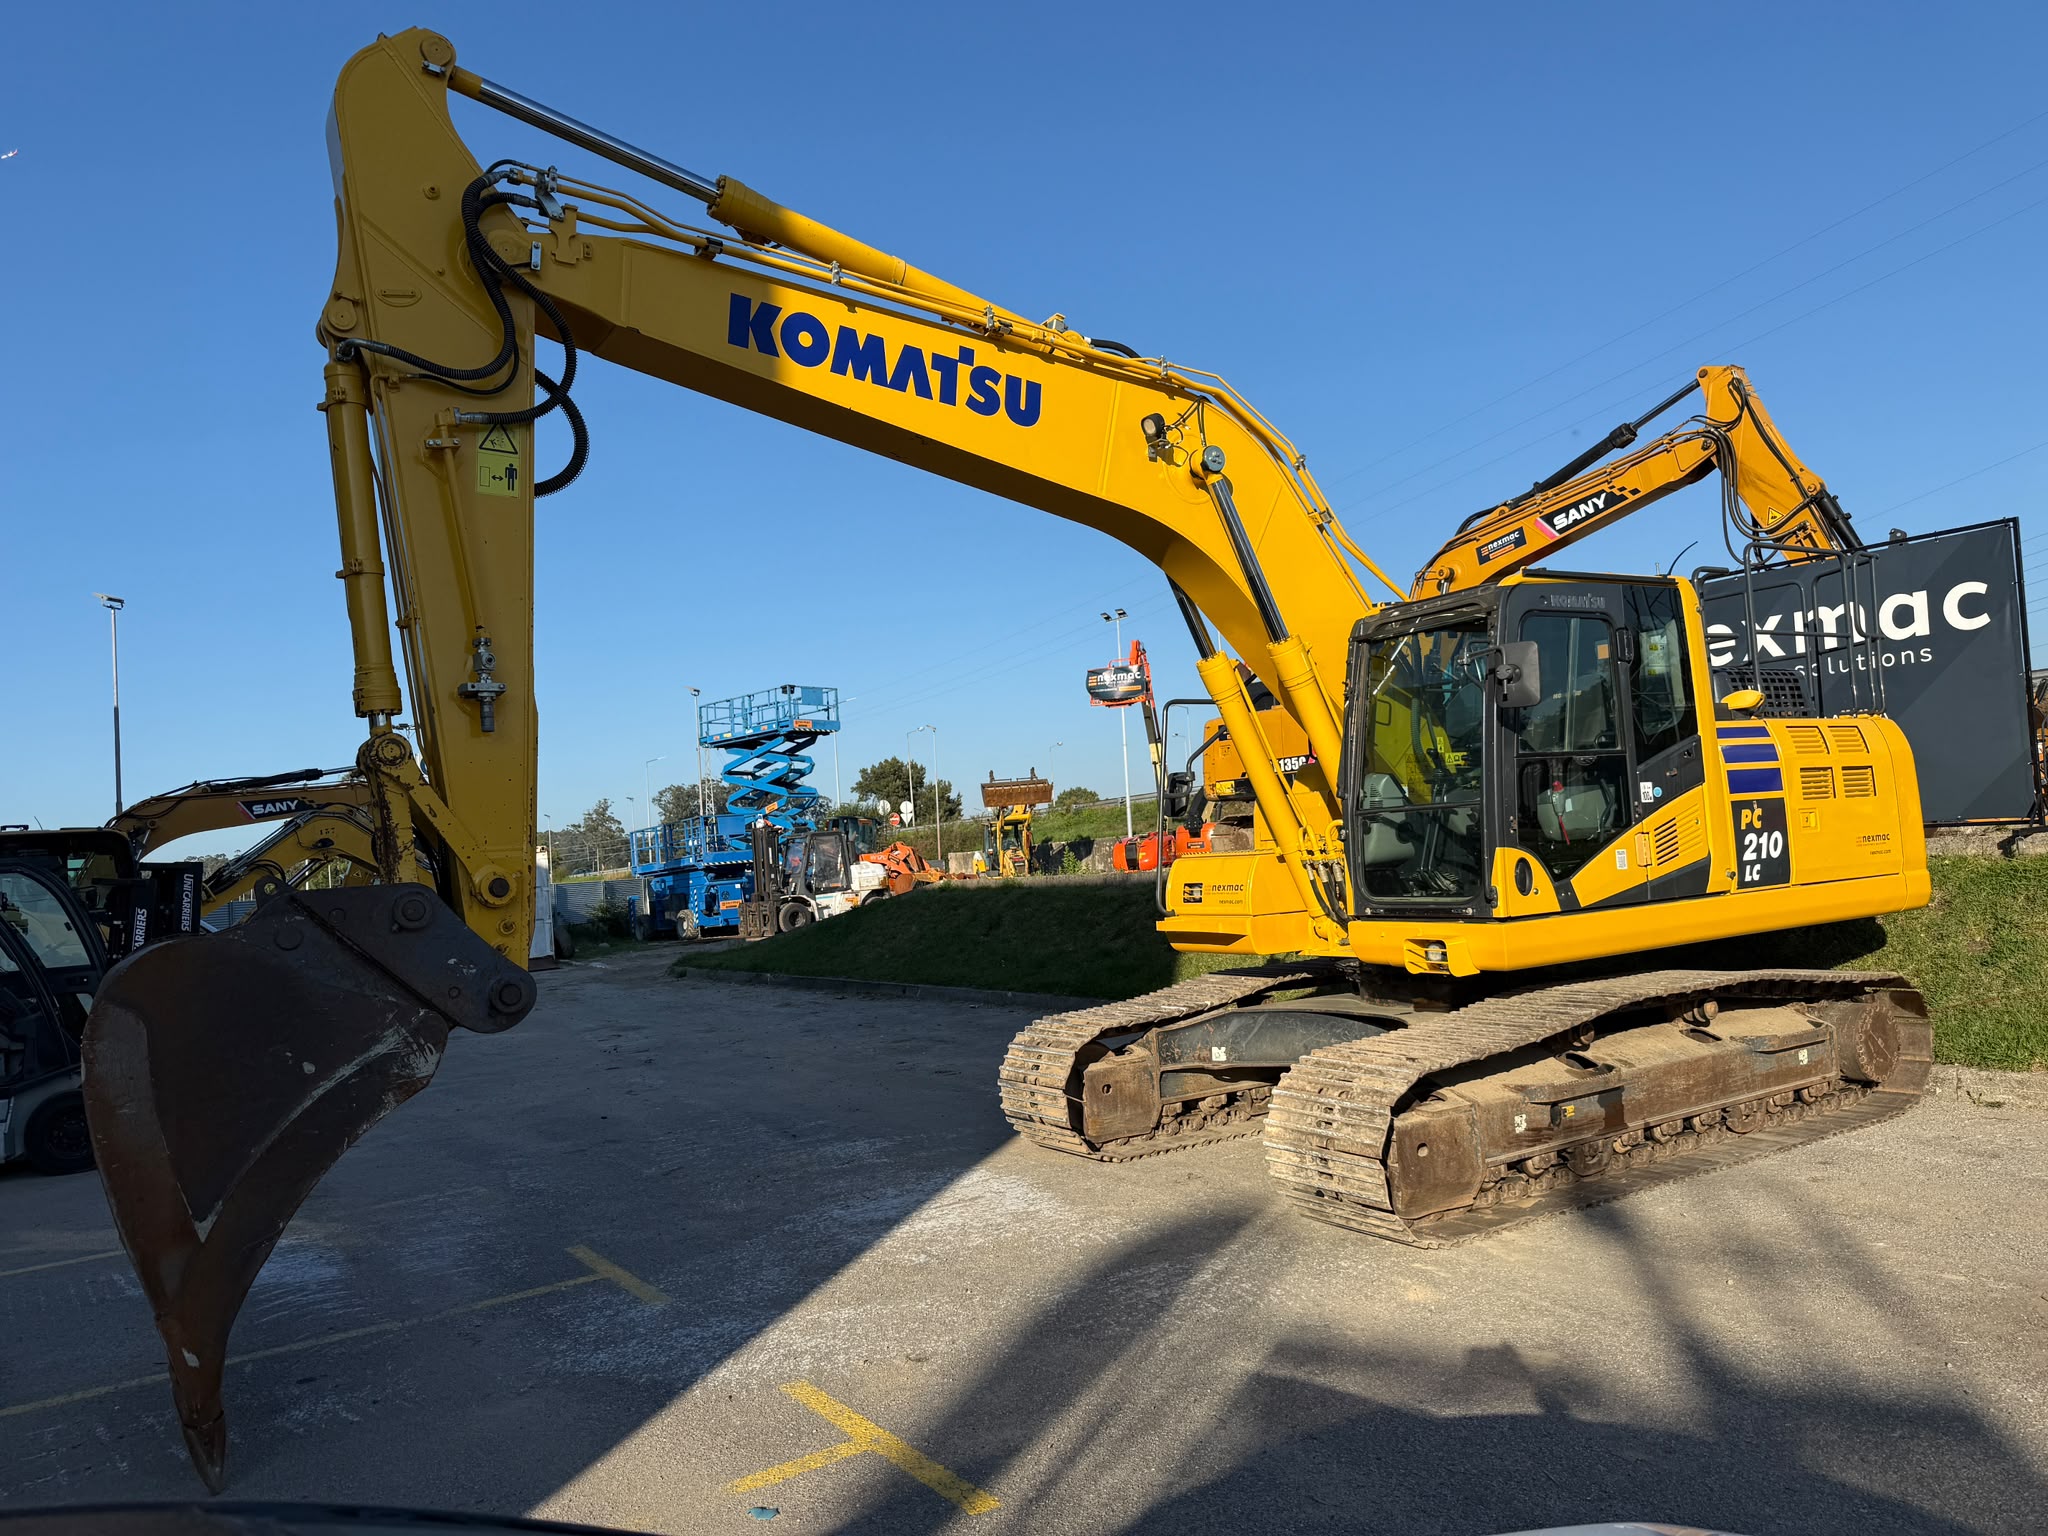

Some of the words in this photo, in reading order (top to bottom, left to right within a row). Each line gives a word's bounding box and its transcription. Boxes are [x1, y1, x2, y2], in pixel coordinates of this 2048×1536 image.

[728, 292, 1042, 427] KOMATSU
[1553, 492, 1607, 531] SANY
[1488, 531, 1520, 550] nexmac
[1550, 593, 1606, 608] KOMATSU
[1707, 581, 1991, 667] exmac
[253, 800, 299, 815] SANY
[1741, 808, 1762, 830] PC
[1743, 831, 1783, 861] 210
[1862, 833, 1890, 843] nexmac
[1744, 864, 1761, 882] LC
[1212, 883, 1244, 892] nexmac
[181, 873, 194, 932] UNICARRIERS
[133, 907, 147, 952] ARRIERS
